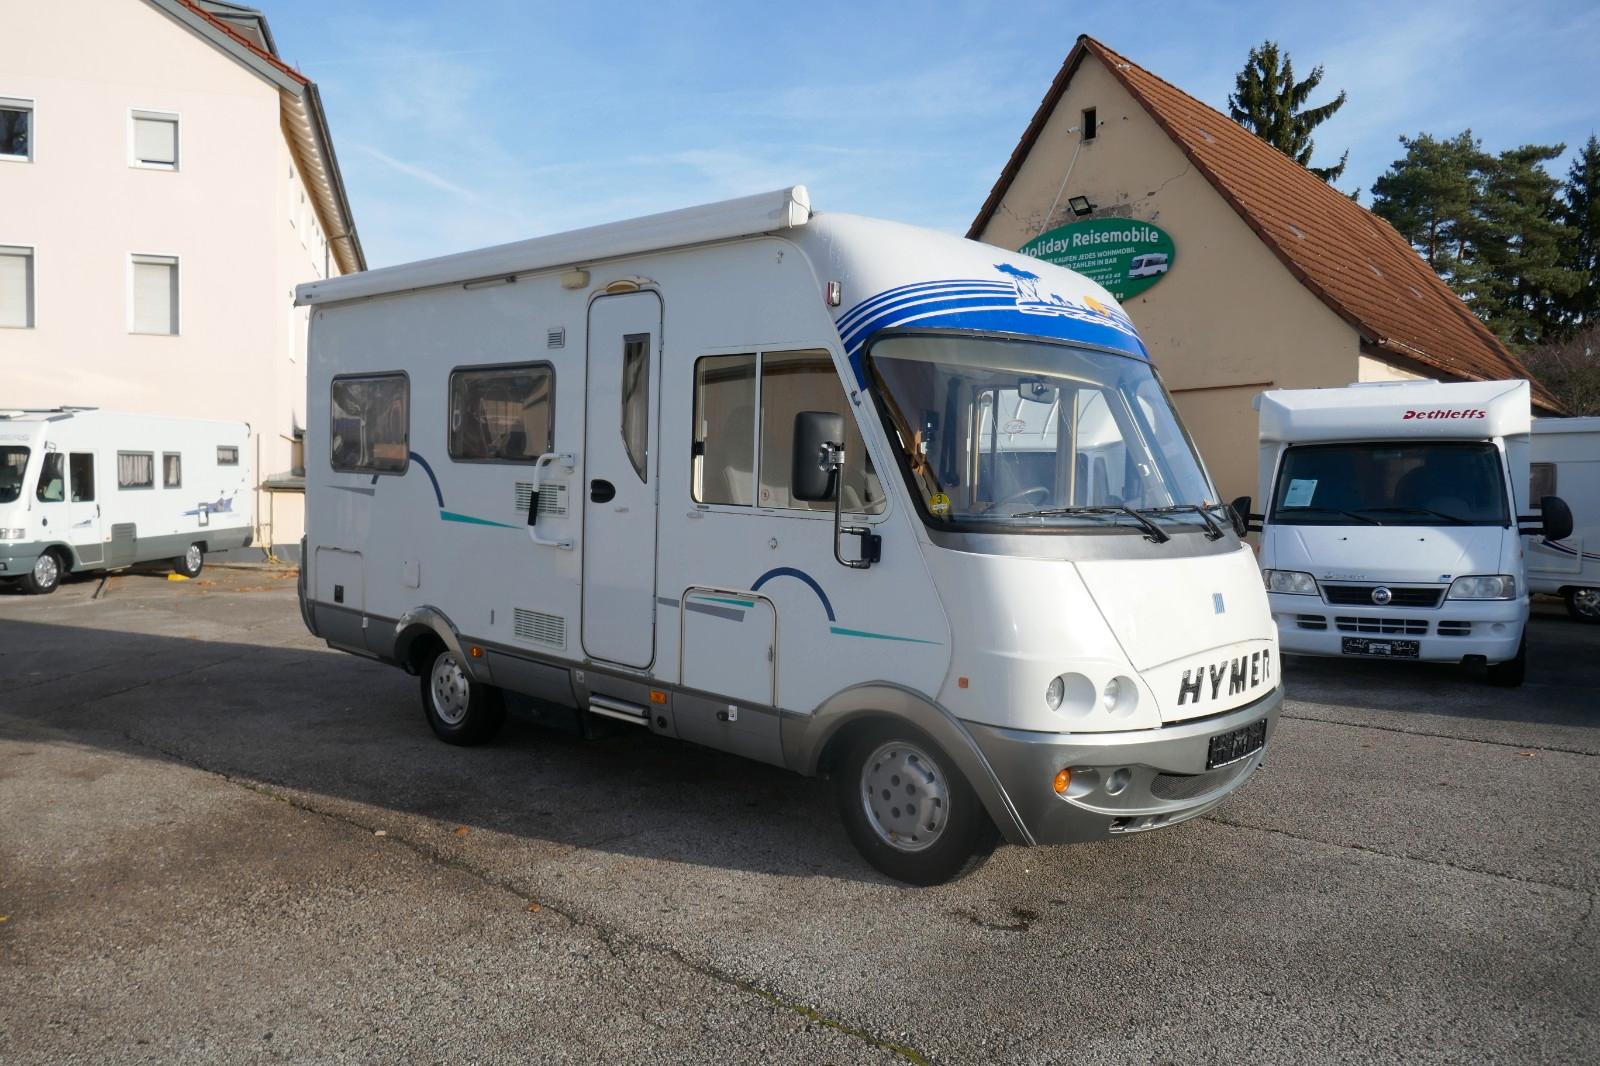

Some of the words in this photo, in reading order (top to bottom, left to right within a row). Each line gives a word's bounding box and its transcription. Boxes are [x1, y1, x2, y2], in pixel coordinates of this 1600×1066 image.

[1072, 226, 1159, 247] Reisemobile
[1054, 255, 1077, 264] KAUFEN
[1078, 252, 1096, 261] JEDES
[1097, 247, 1136, 258] WOHNMOBIL
[1073, 261, 1096, 269] ZAHLEN
[1104, 257, 1117, 265] BAR
[1402, 409, 1486, 420] Dethleffs
[1177, 648, 1270, 706] HYMER
